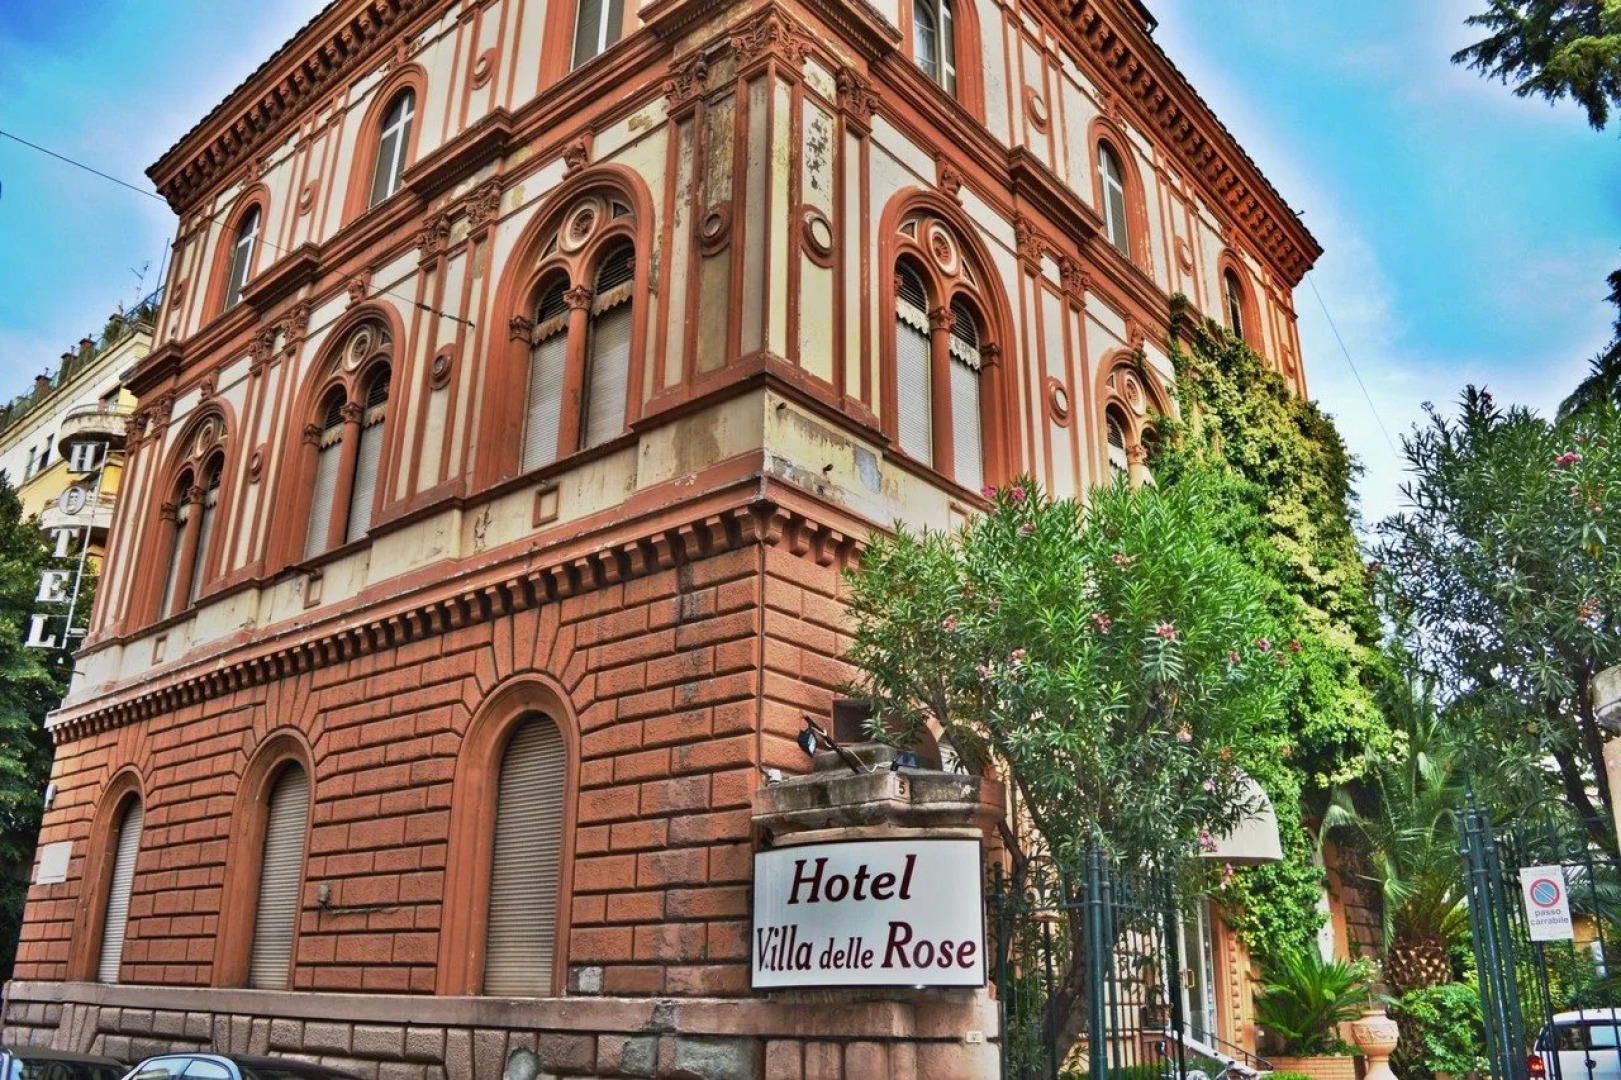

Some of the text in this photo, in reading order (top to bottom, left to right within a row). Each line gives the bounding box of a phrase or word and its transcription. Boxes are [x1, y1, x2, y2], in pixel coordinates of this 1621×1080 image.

[24, 442, 98, 648] HOTEL
[787, 854, 917, 904] Hotel
[1530, 917, 1569, 926] carrabile
[1534, 908, 1561, 917] passo
[757, 921, 976, 971] Villa delle Rose
